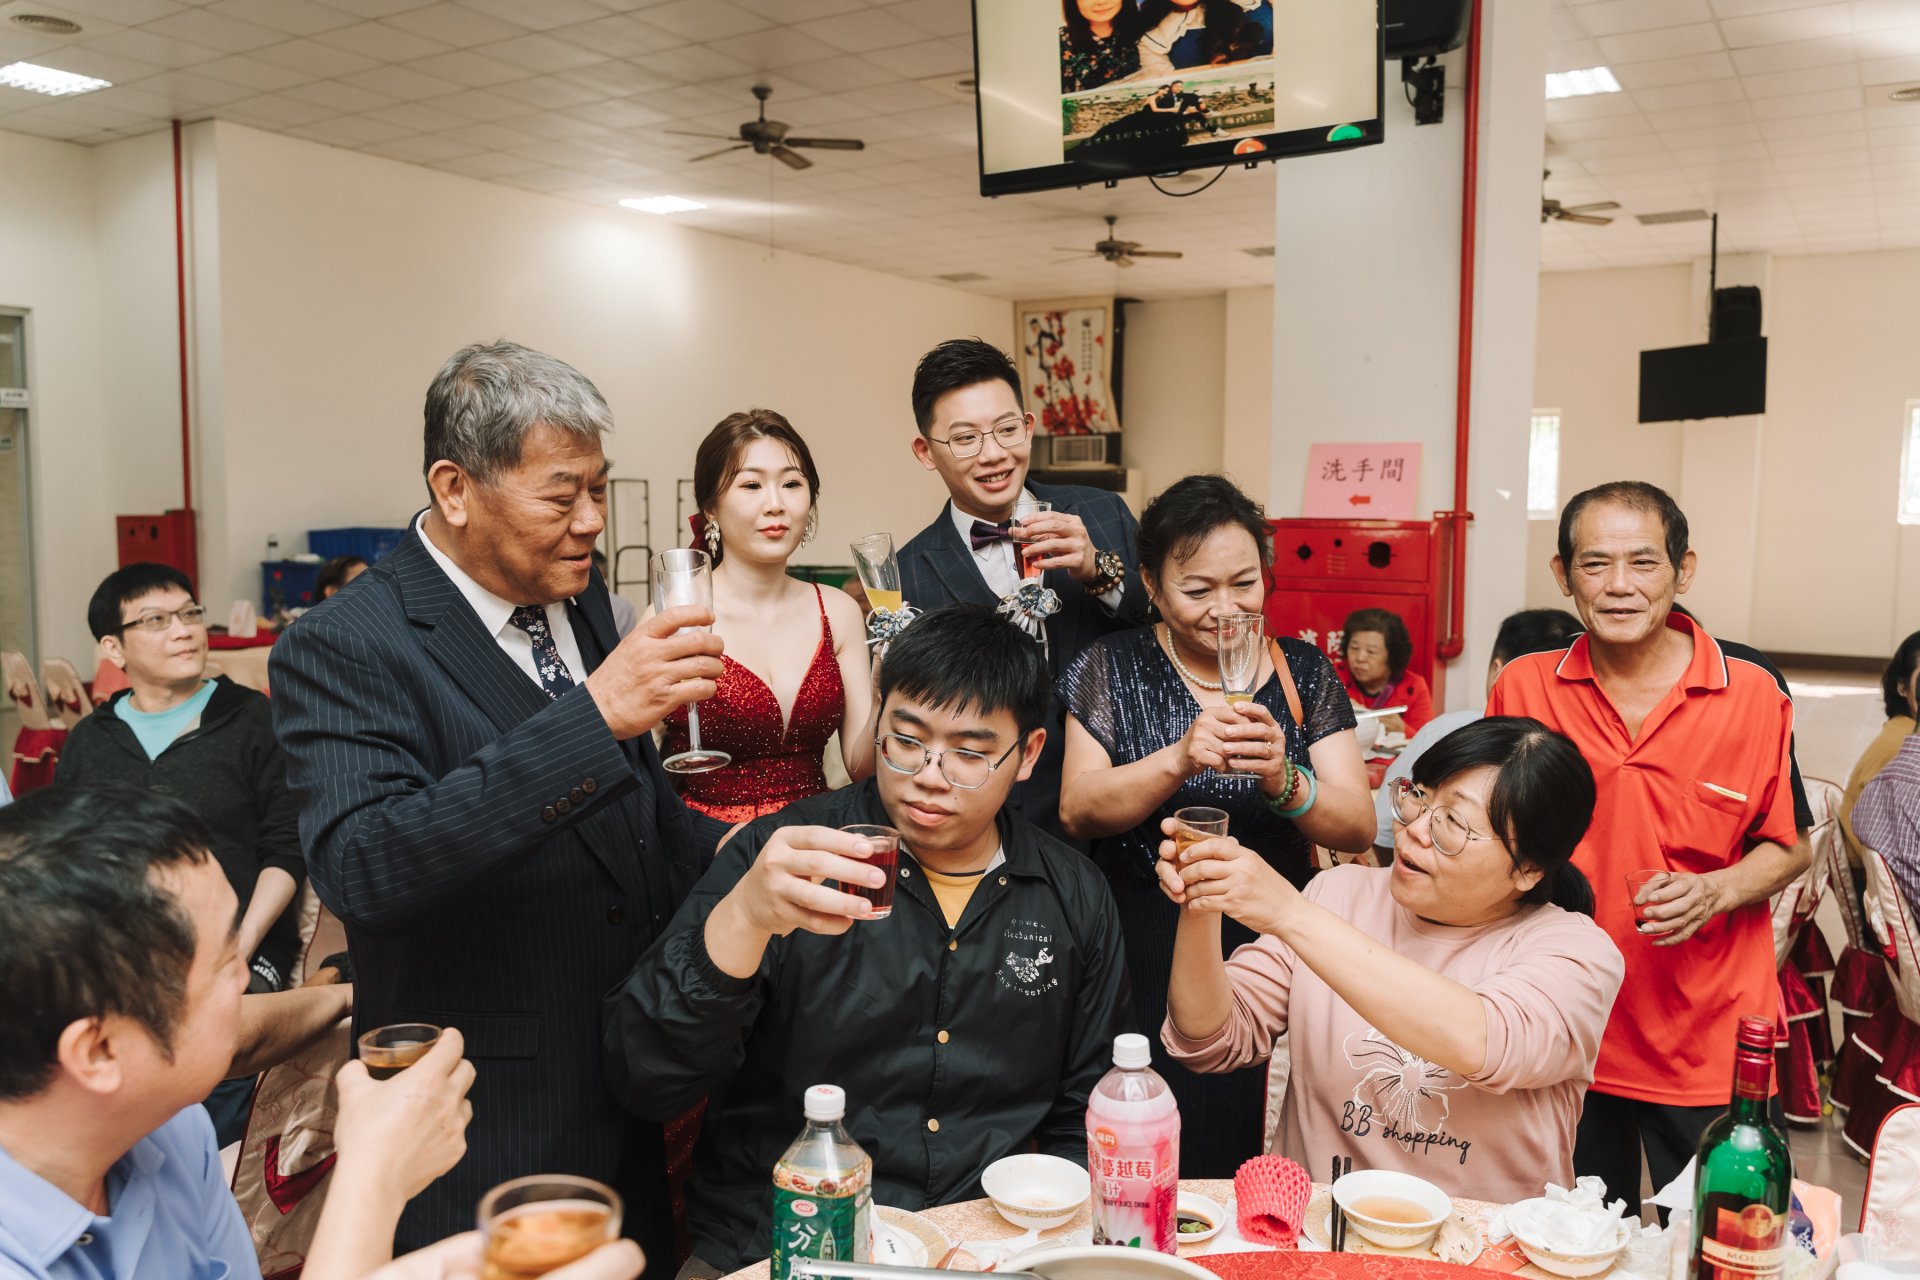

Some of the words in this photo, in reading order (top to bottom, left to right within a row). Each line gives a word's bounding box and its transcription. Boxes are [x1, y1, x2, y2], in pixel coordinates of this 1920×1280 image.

[1322, 457, 1405, 482] 洗手間
[1340, 1100, 1373, 1137] BB
[1382, 1120, 1472, 1165] shopping
